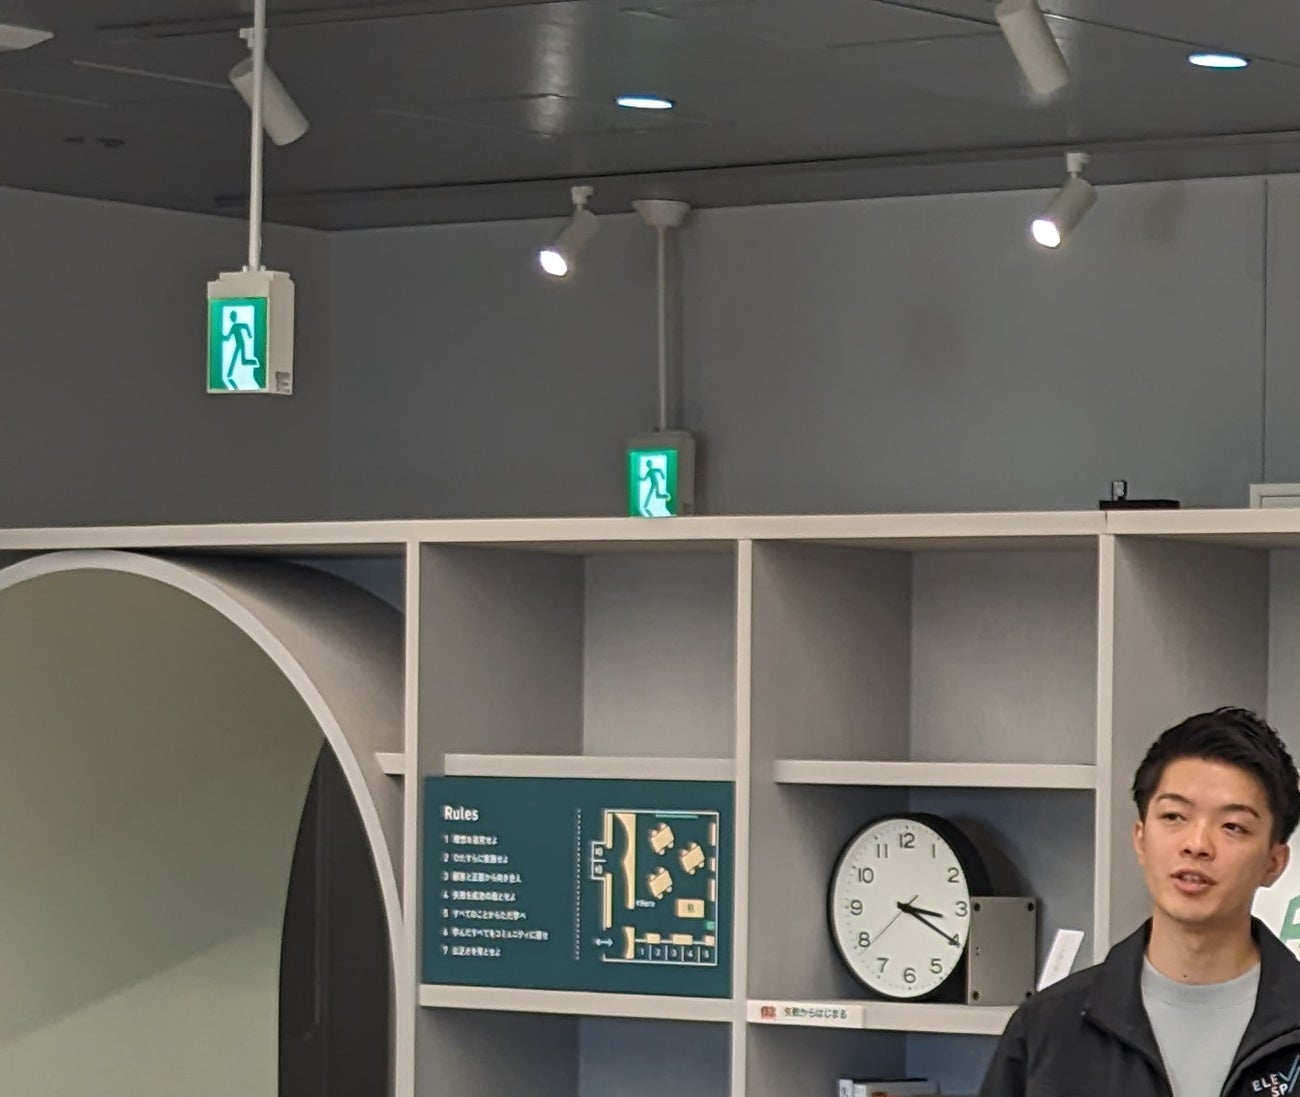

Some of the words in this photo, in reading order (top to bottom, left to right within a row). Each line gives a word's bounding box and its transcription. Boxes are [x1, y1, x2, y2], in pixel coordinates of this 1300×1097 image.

[444, 804, 480, 822] Rules
[899, 832, 916, 849] 12
[876, 843, 889, 859] 11
[931, 843, 937, 859] 1
[858, 866, 875, 884] 10
[947, 867, 961, 884] 2
[849, 899, 864, 916] 9
[954, 900, 969, 918] 3
[857, 931, 872, 949] 8
[876, 956, 890, 974] 7
[929, 957, 944, 975] 5
[903, 966, 917, 984] 6
